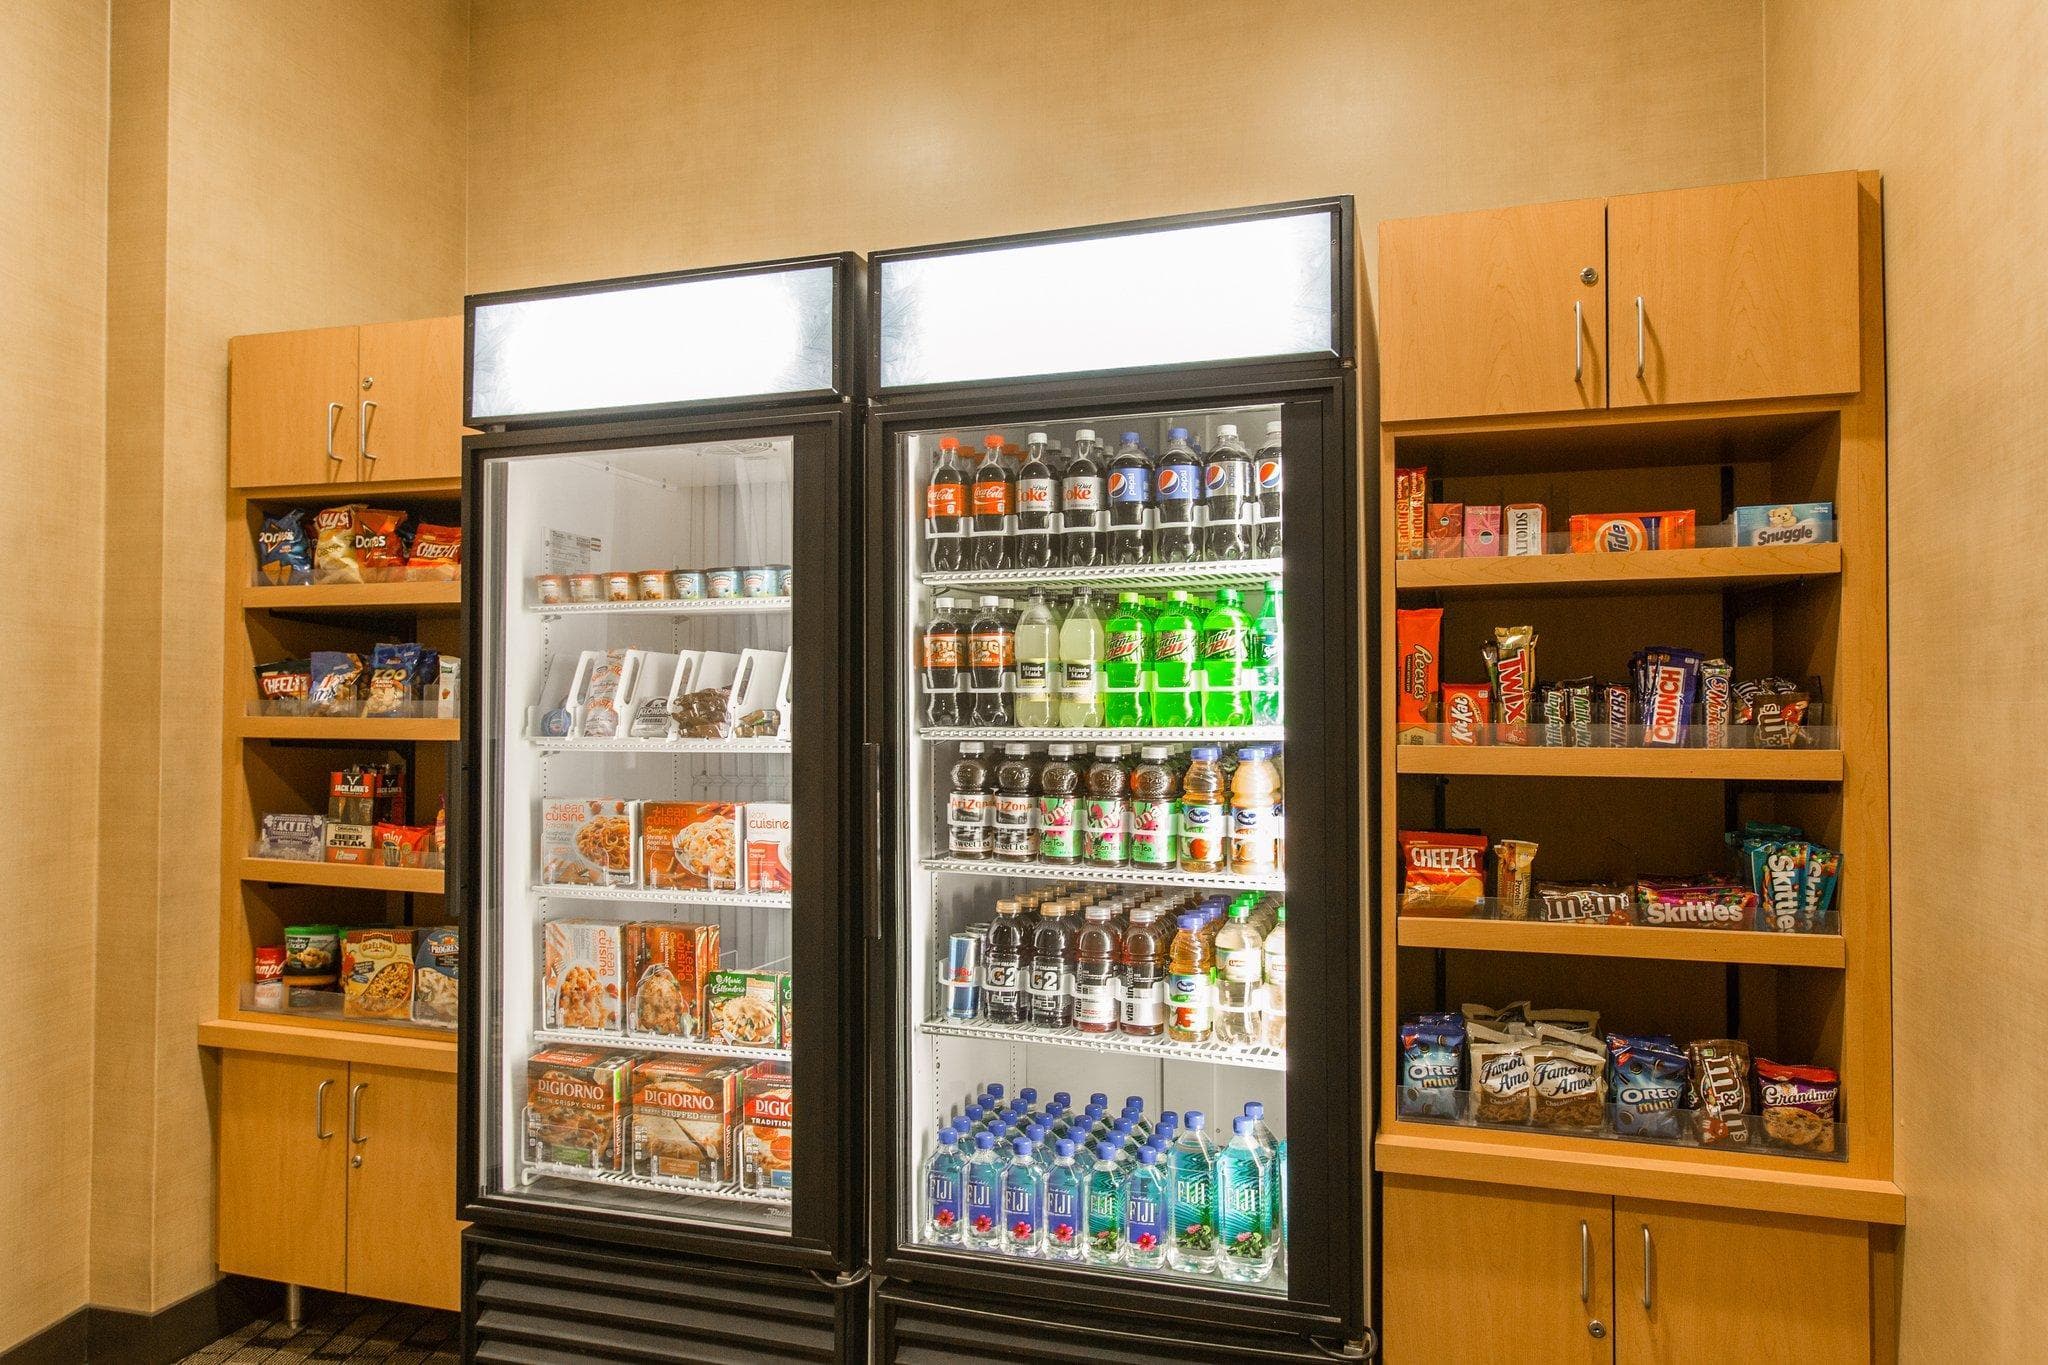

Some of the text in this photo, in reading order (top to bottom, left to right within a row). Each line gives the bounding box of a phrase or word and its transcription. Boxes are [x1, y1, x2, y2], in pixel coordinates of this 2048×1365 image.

[1128, 473, 1136, 496] pepsi
[1516, 512, 1528, 556] ALTOIDS
[1758, 525, 1813, 545] Snuggle
[1413, 644, 1433, 701] Reese's
[1498, 649, 1526, 725] TWIX
[1610, 687, 1627, 745] NICKERS
[1654, 669, 1682, 741] CRUNCH
[545, 812, 585, 822] cuisine
[994, 801, 1032, 812] riZona
[276, 821, 295, 832] ACT
[646, 815, 688, 826] cuisine
[749, 818, 790, 830] cuisine
[329, 839, 366, 848] STEAK
[1411, 846, 1478, 870] CHEEZ-IT
[1514, 880, 1523, 906] Protein
[1647, 901, 1744, 924] Skittles
[599, 929, 607, 977] cuisine
[676, 932, 686, 981] cuisine
[988, 967, 1015, 986] G2
[1031, 971, 1058, 991] G2
[1533, 1062, 1596, 1087] Famous
[538, 1079, 604, 1101] DIGIORNO
[1548, 1078, 1595, 1097] Amos
[1621, 1087, 1679, 1105] OREO
[644, 1090, 715, 1110] DIGIORNO
[1638, 1099, 1674, 1113] mini
[661, 1109, 700, 1119] STUFFED
[930, 1178, 952, 1200] FIJI
[968, 1184, 990, 1206] FIJI
[1177, 1180, 1205, 1205] FIJI
[1226, 1186, 1257, 1212] FIJI
[1005, 1190, 1029, 1212] FIJI
[1048, 1192, 1071, 1214] FIJI
[1091, 1195, 1113, 1216] FIJI
[1129, 1201, 1155, 1223] FIJI
